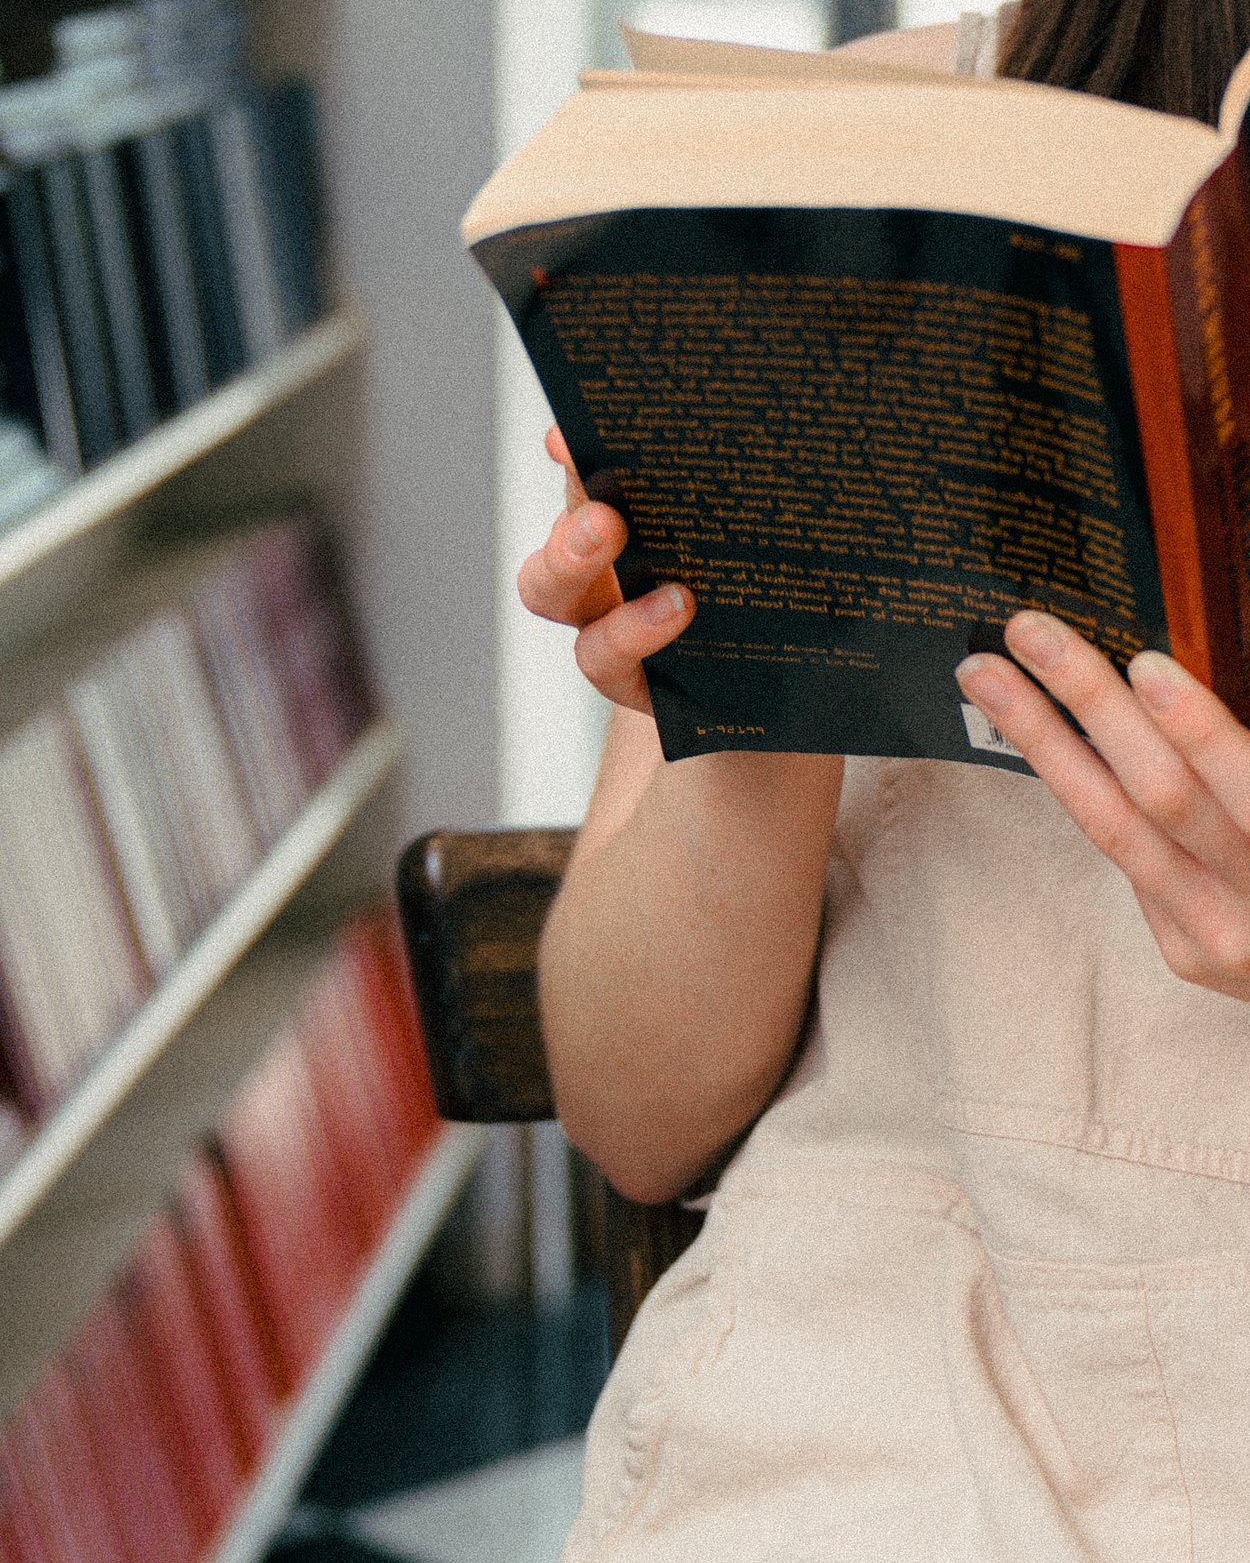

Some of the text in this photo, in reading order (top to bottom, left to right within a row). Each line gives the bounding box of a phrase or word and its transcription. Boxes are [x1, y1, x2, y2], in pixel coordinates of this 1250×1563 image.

[677, 551, 705, 565] The
[708, 558, 758, 572] poems
[760, 562, 776, 571] in
[779, 560, 805, 575] this
[808, 564, 861, 580] volume
[864, 573, 902, 585] were
[715, 593, 745, 607] and
[750, 596, 784, 610] most
[788, 599, 829, 614] loved
[834, 605, 867, 621] poet
[871, 608, 887, 620] of
